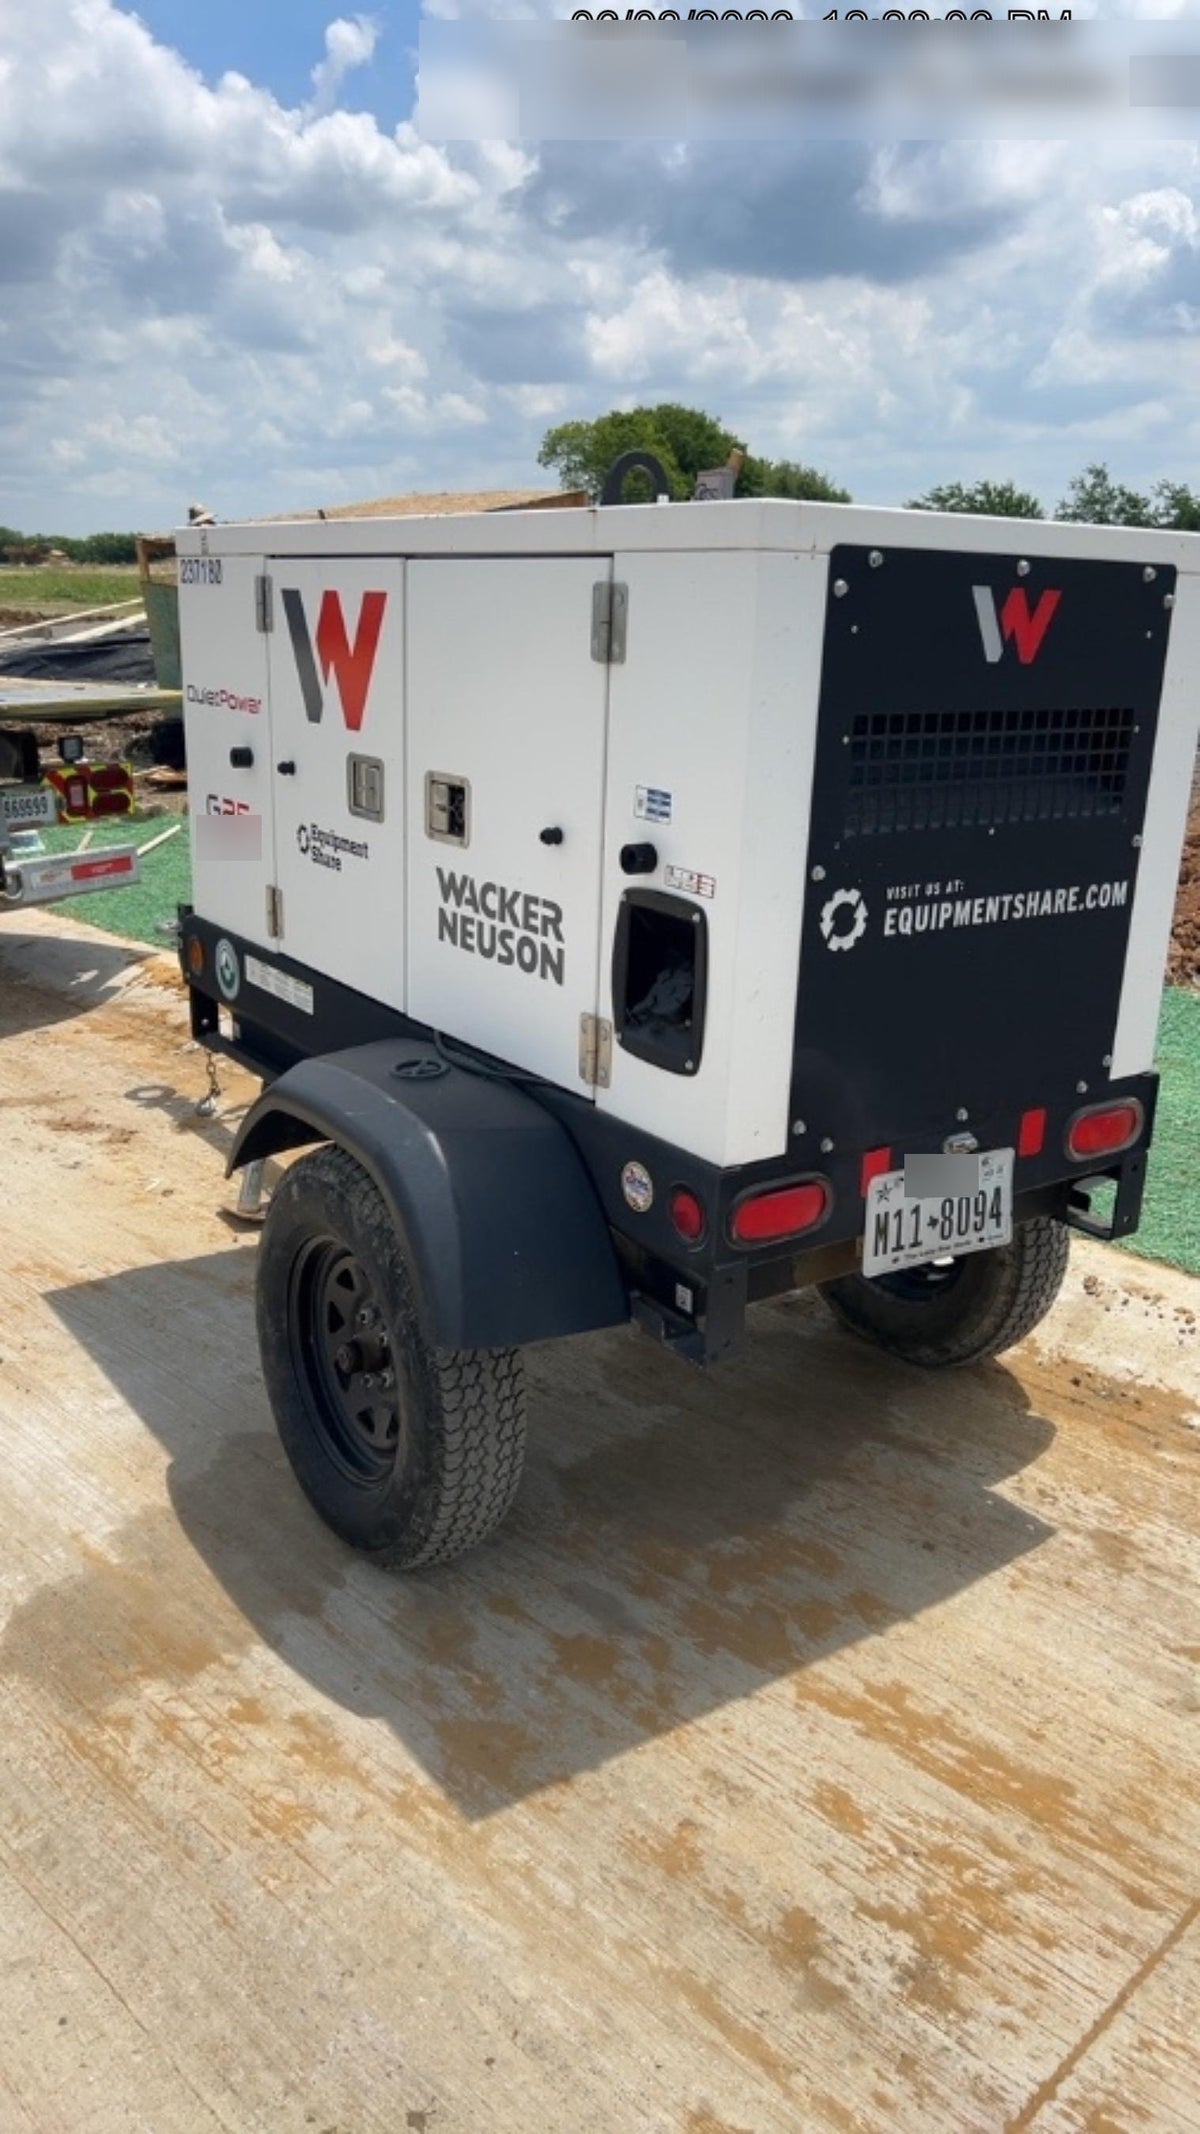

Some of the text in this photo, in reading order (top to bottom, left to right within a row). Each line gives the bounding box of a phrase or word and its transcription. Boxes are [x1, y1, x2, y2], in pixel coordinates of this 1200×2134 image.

[180, 558, 222, 585] 237180
[187, 684, 262, 714] QuietPower
[310, 822, 369, 860] Equipment
[311, 845, 342, 871] Share
[436, 866, 565, 944] WACKER
[886, 878, 964, 900] VISIT US AT:
[884, 881, 1129, 936] EQUIPMENTSHARE.COM
[438, 907, 565, 986] NEUSON
